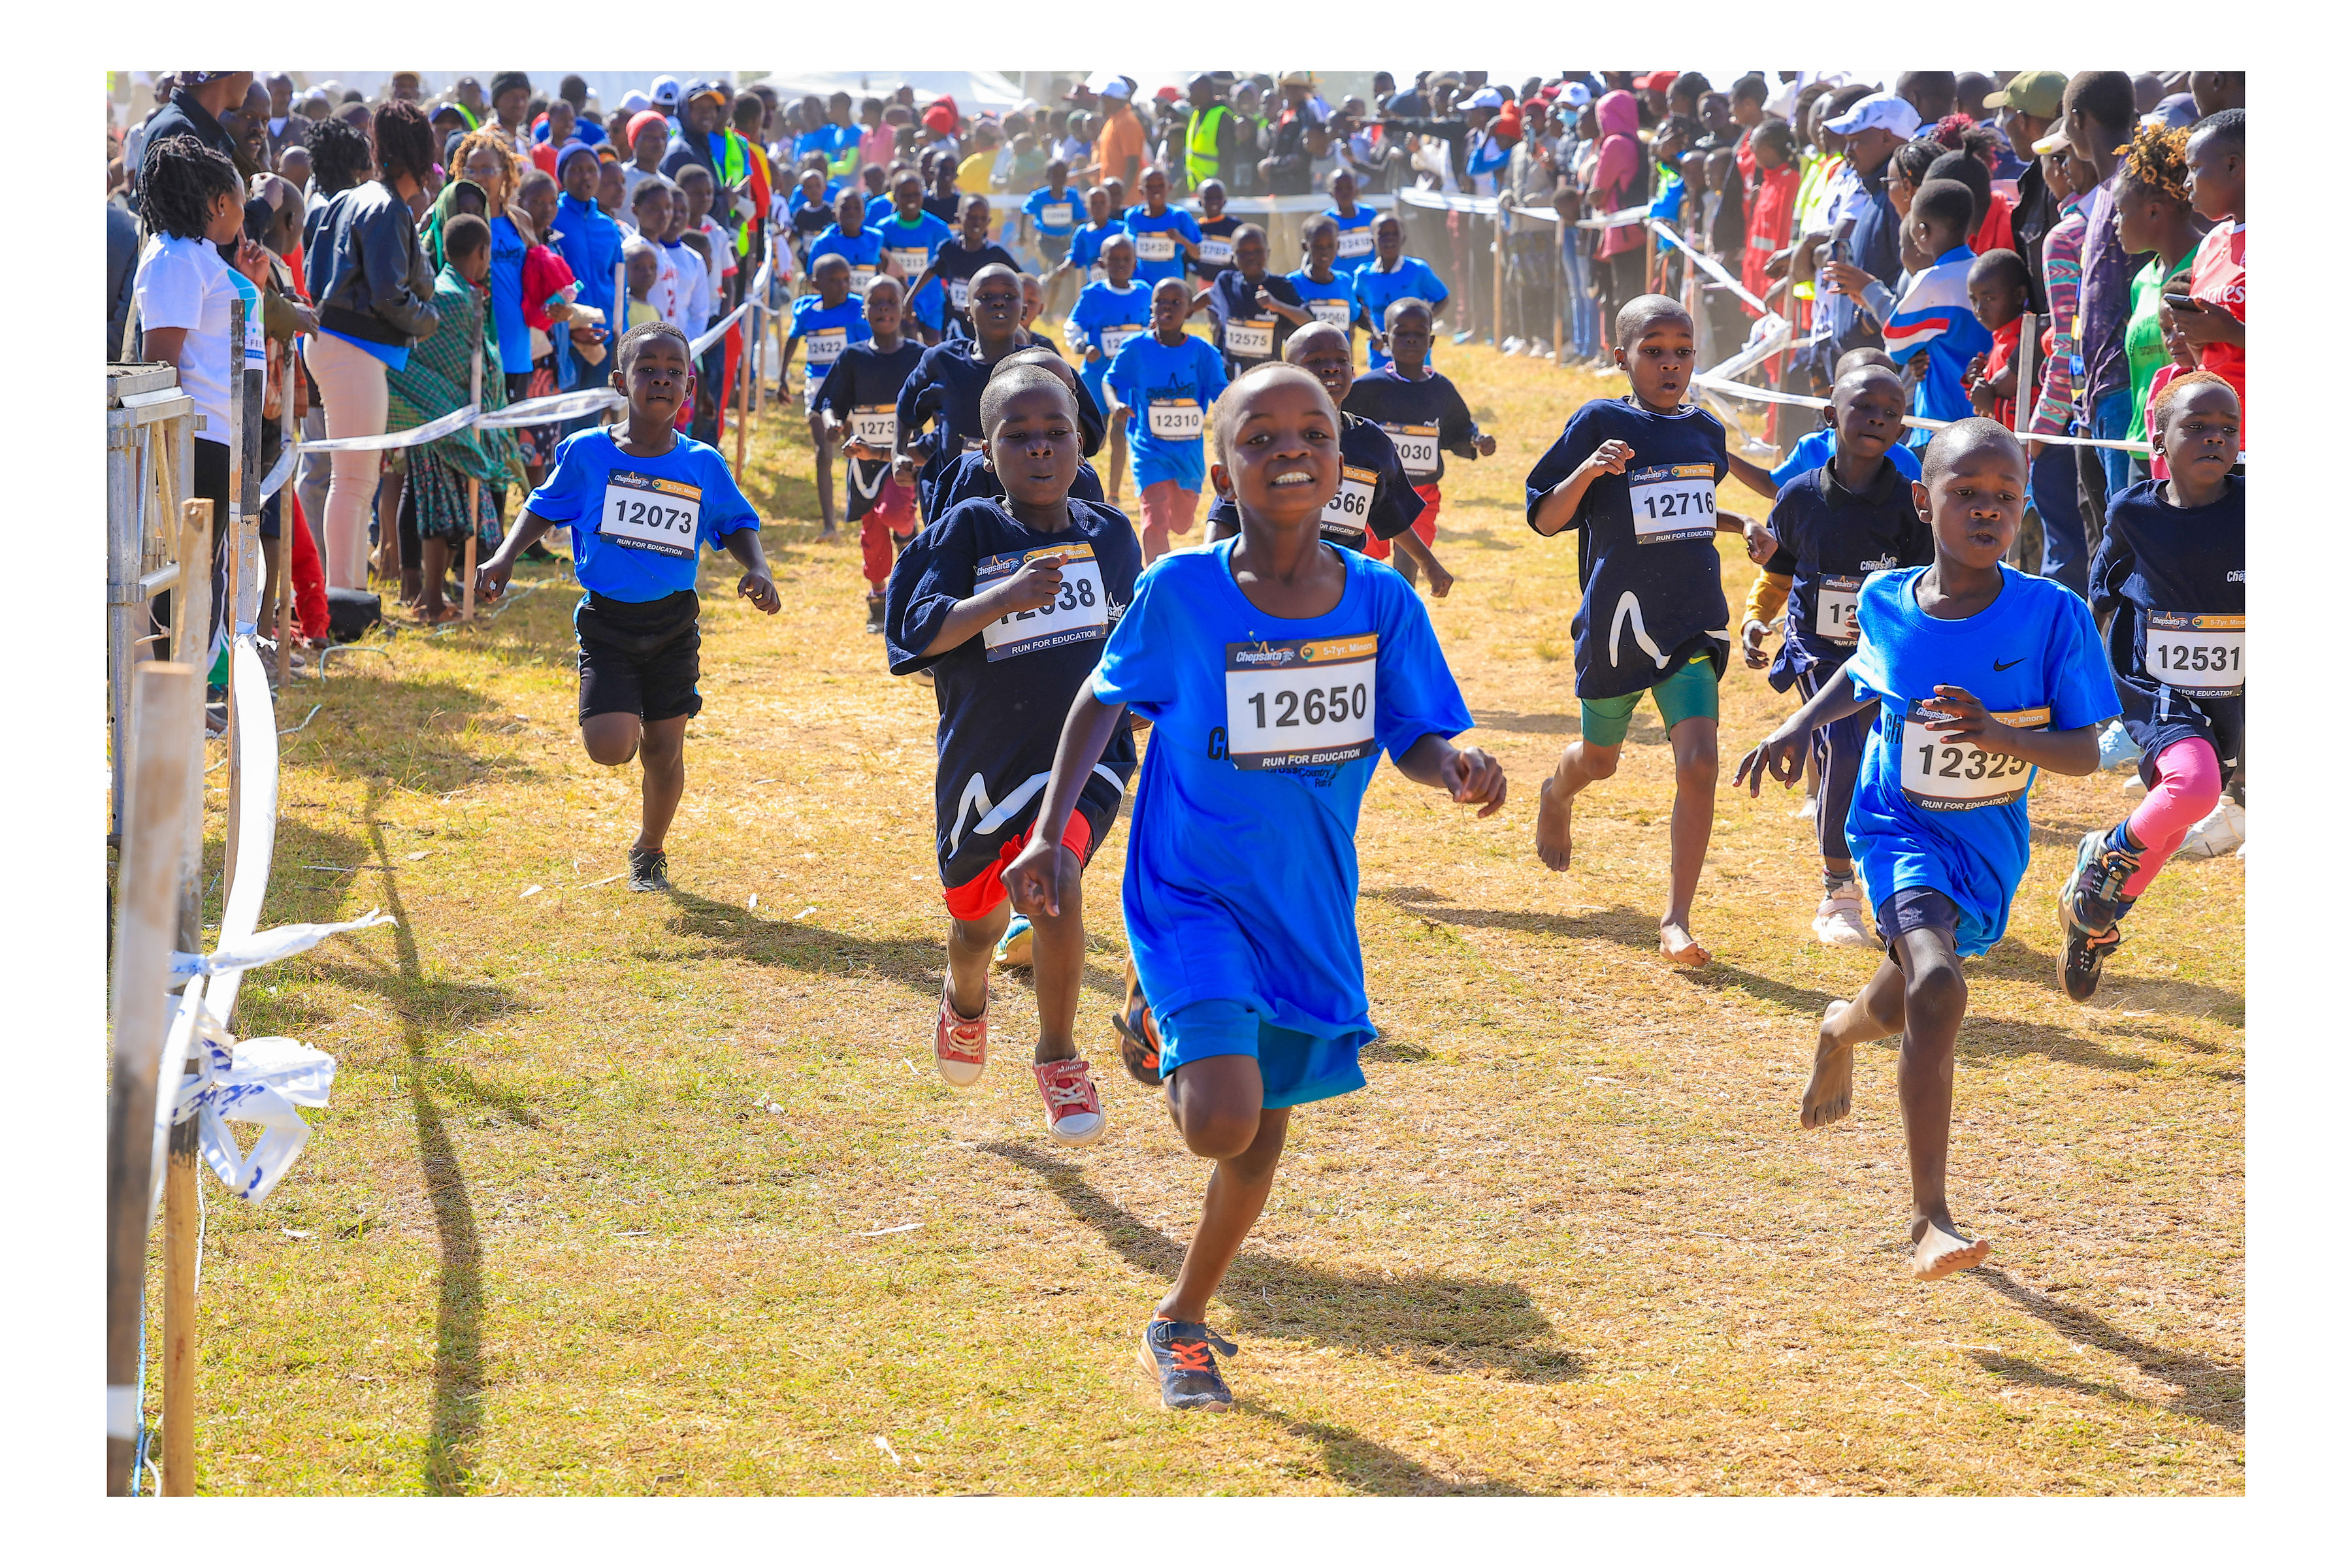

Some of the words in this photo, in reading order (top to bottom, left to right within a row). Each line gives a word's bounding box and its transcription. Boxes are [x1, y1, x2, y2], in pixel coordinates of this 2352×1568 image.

[1229, 332, 1268, 348] 12575
[1156, 414, 1199, 428] 12310
[614, 474, 642, 485] Chepsaita
[1634, 470, 1661, 482] Chepsaita
[1324, 491, 1366, 515] 566
[1644, 491, 1714, 519] 12716
[616, 500, 692, 534] 12073
[616, 538, 631, 546] RUN
[632, 540, 646, 549] FOR
[647, 544, 683, 556] EDUCATION
[977, 560, 1010, 576] Chepsaita
[1825, 579, 1853, 588] Chepsaita
[2152, 615, 2180, 627] Chepsaita
[1012, 642, 1031, 655] RUN
[1032, 636, 1051, 649] FOR
[1052, 629, 1097, 645] EDUCATION
[1323, 645, 1348, 657] 5-7yr.
[1349, 642, 1373, 653] Minors
[1236, 649, 1282, 664] Chepsaita
[2158, 644, 2240, 672] 12531
[2196, 689, 2233, 698] EDUCATION
[1249, 683, 1367, 728] 12650
[2019, 715, 2044, 724] Minors
[1262, 757, 1286, 768] RUN
[1288, 754, 1310, 765] FOR
[1311, 748, 1362, 764] EDUCATION
[1919, 743, 2027, 780] 12325
[1921, 799, 1943, 810] RUN
[1944, 801, 1965, 810] FOR
[1965, 795, 2009, 809] EDUCATION
